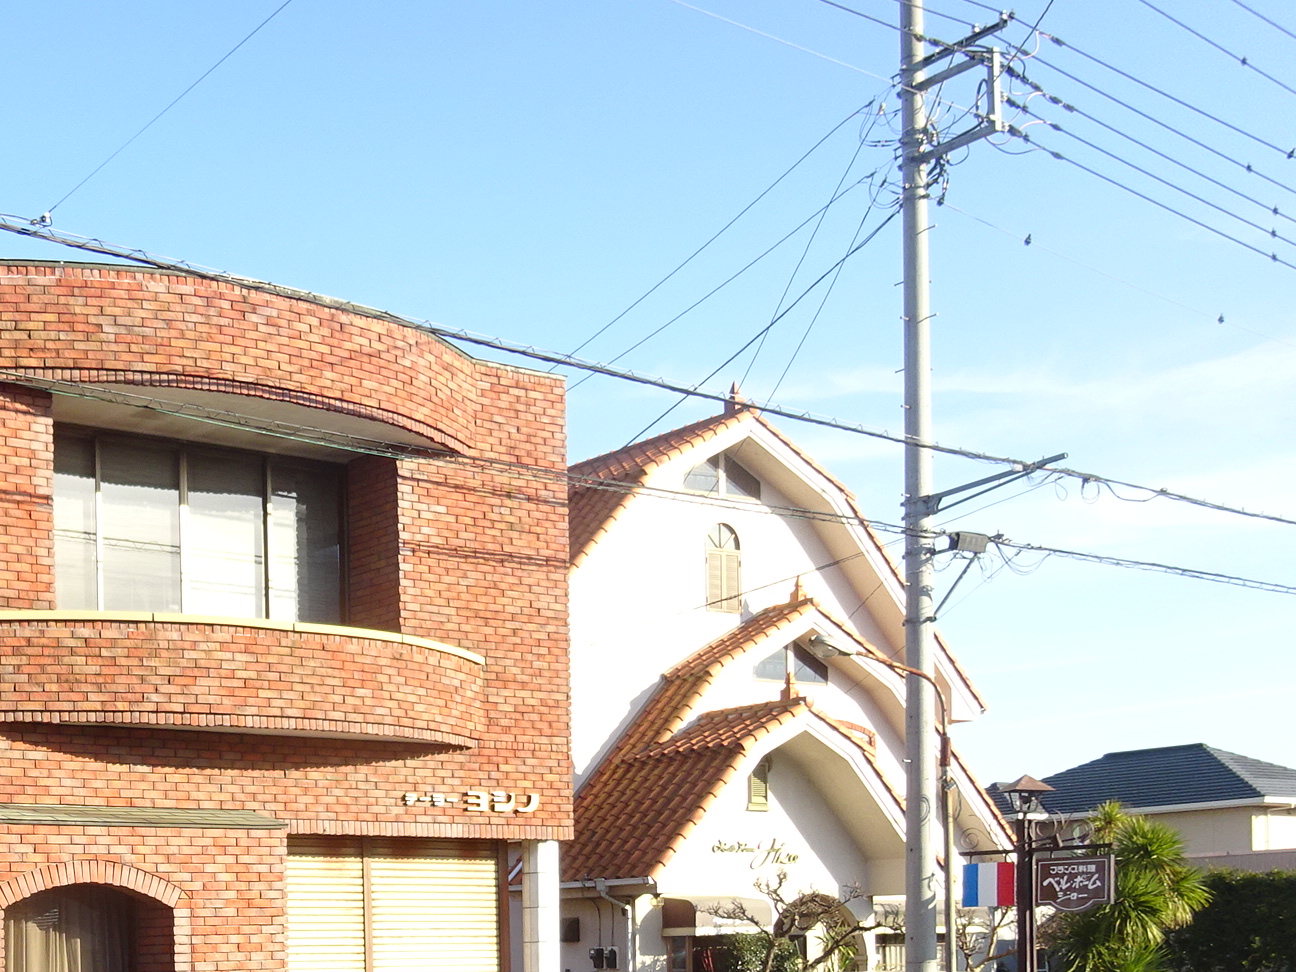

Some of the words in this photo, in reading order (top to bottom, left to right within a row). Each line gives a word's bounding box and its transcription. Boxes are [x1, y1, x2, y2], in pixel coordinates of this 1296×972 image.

[1049, 864, 1097, 874] フランス料理
